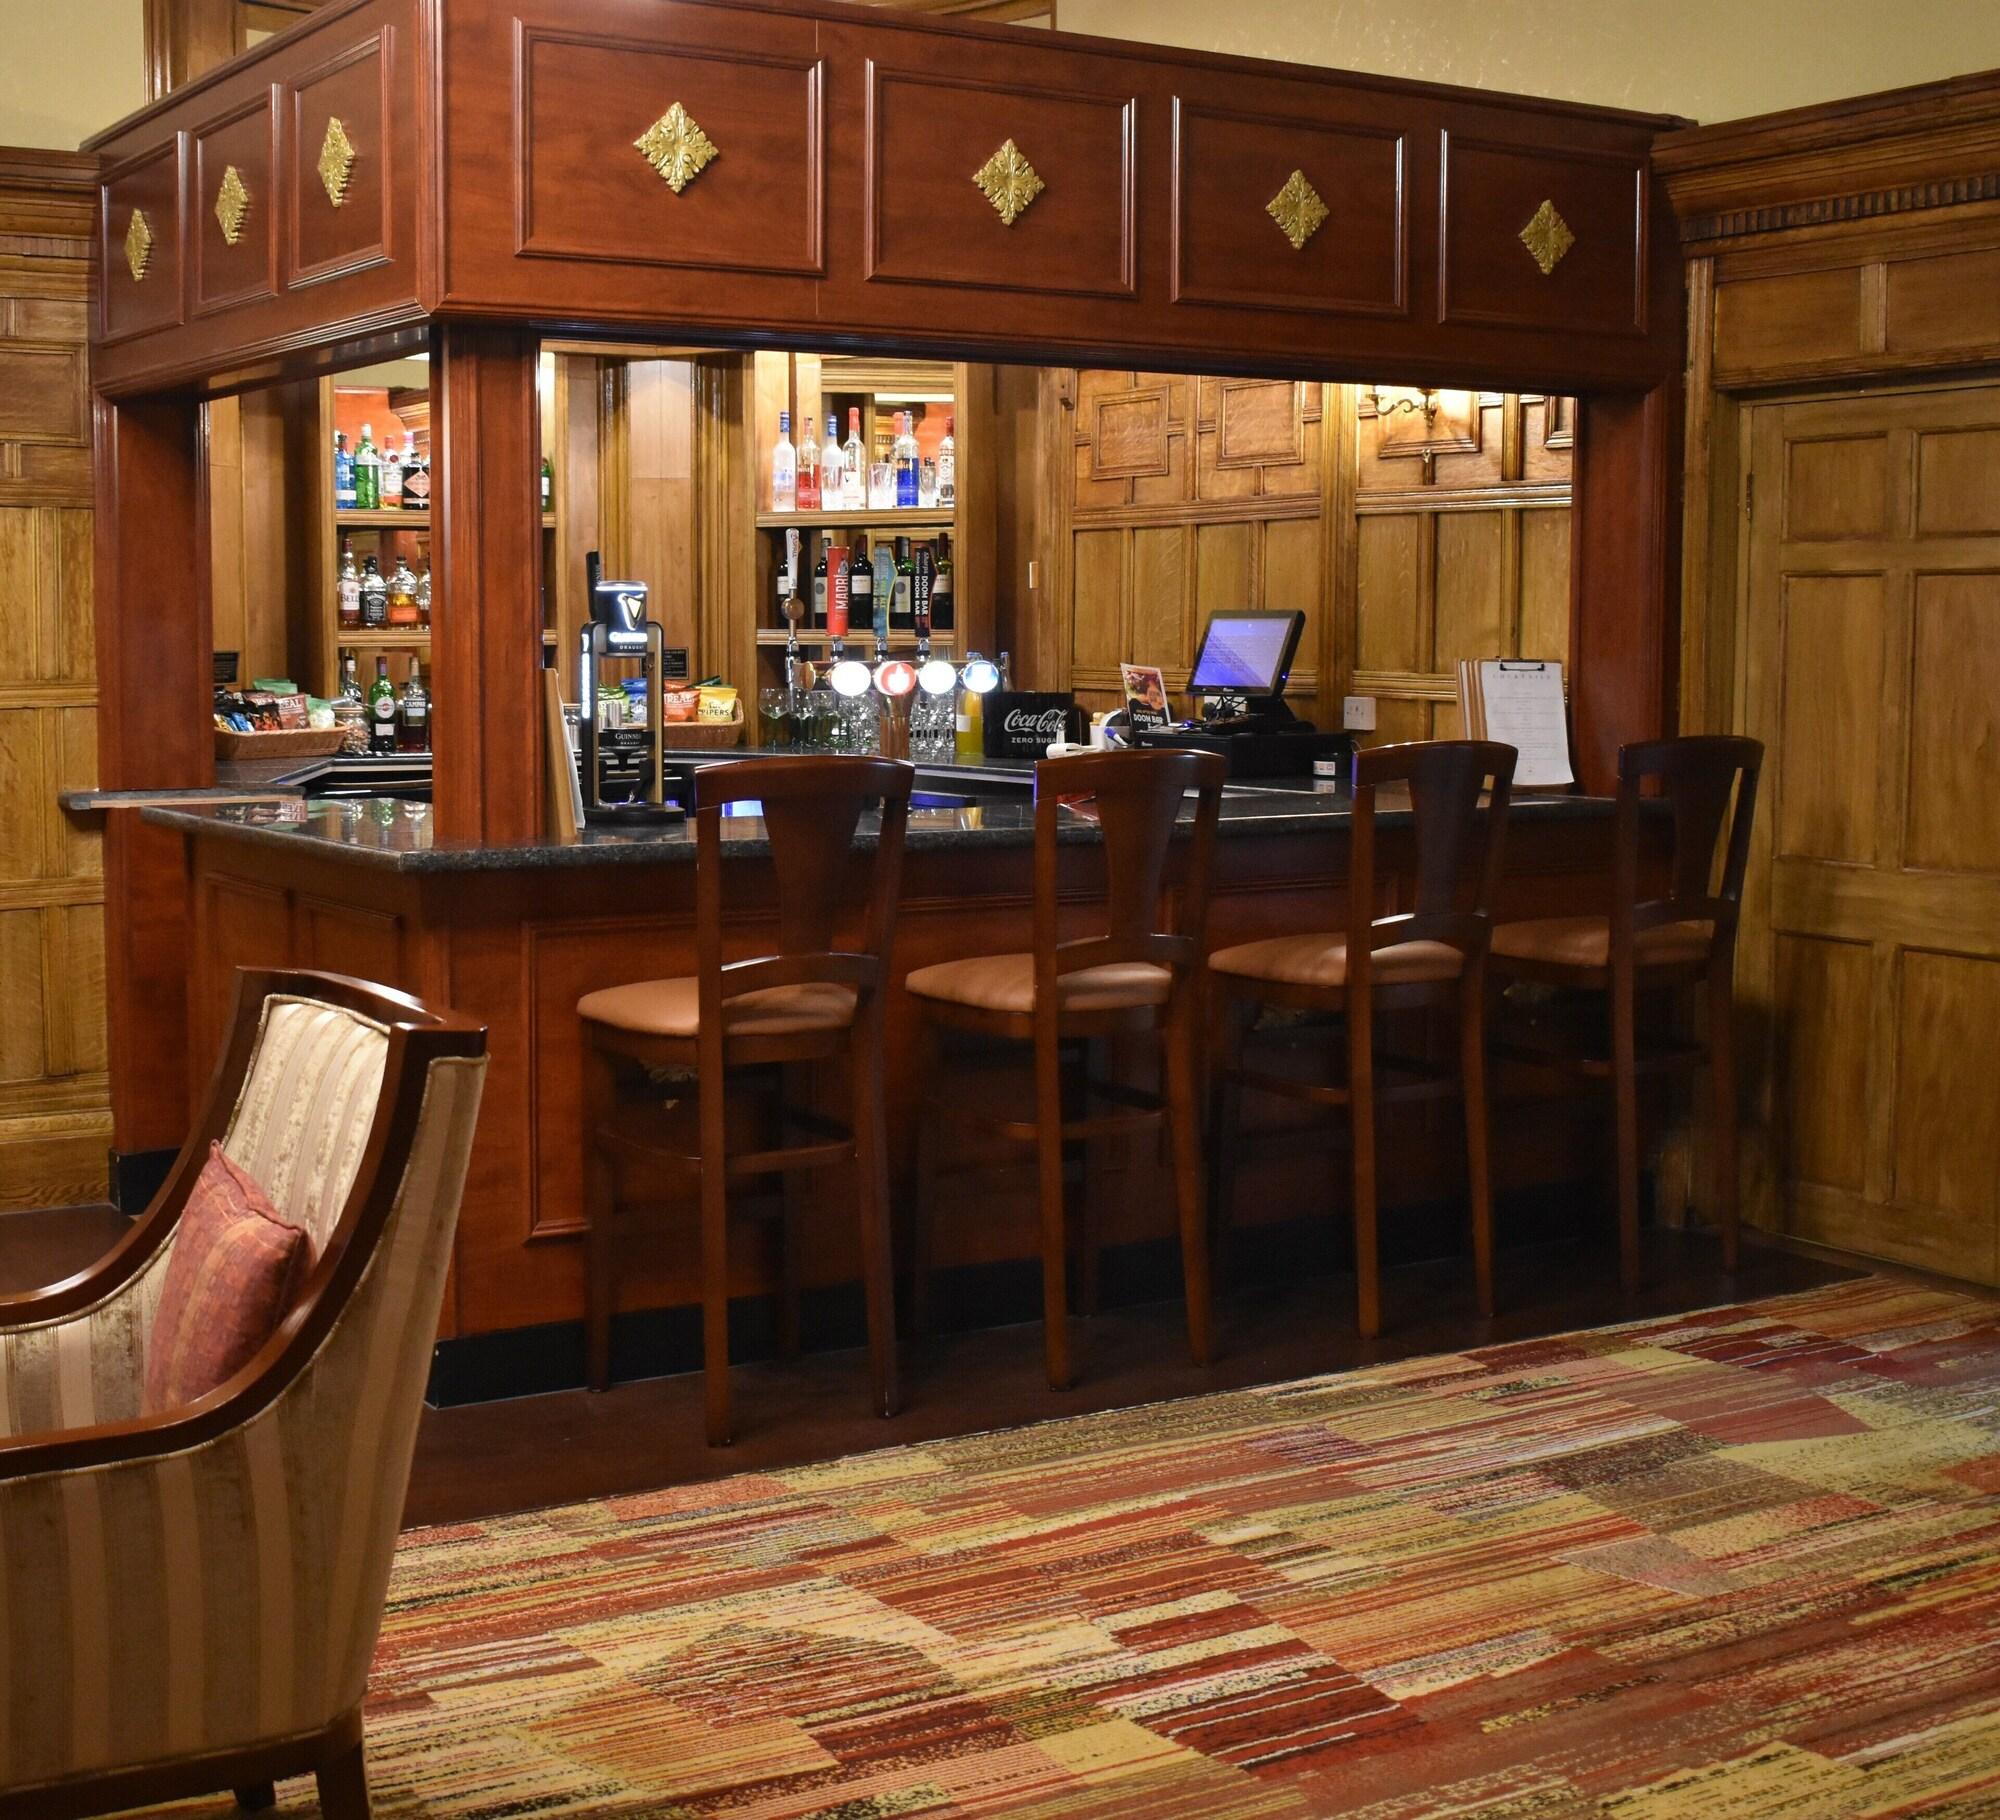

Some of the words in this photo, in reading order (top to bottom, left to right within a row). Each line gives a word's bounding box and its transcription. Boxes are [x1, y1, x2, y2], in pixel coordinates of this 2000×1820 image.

[701, 709, 730, 717] PIPERS
[1133, 713, 1151, 723] DOOM
[1004, 708, 1068, 733] Coca-Cola
